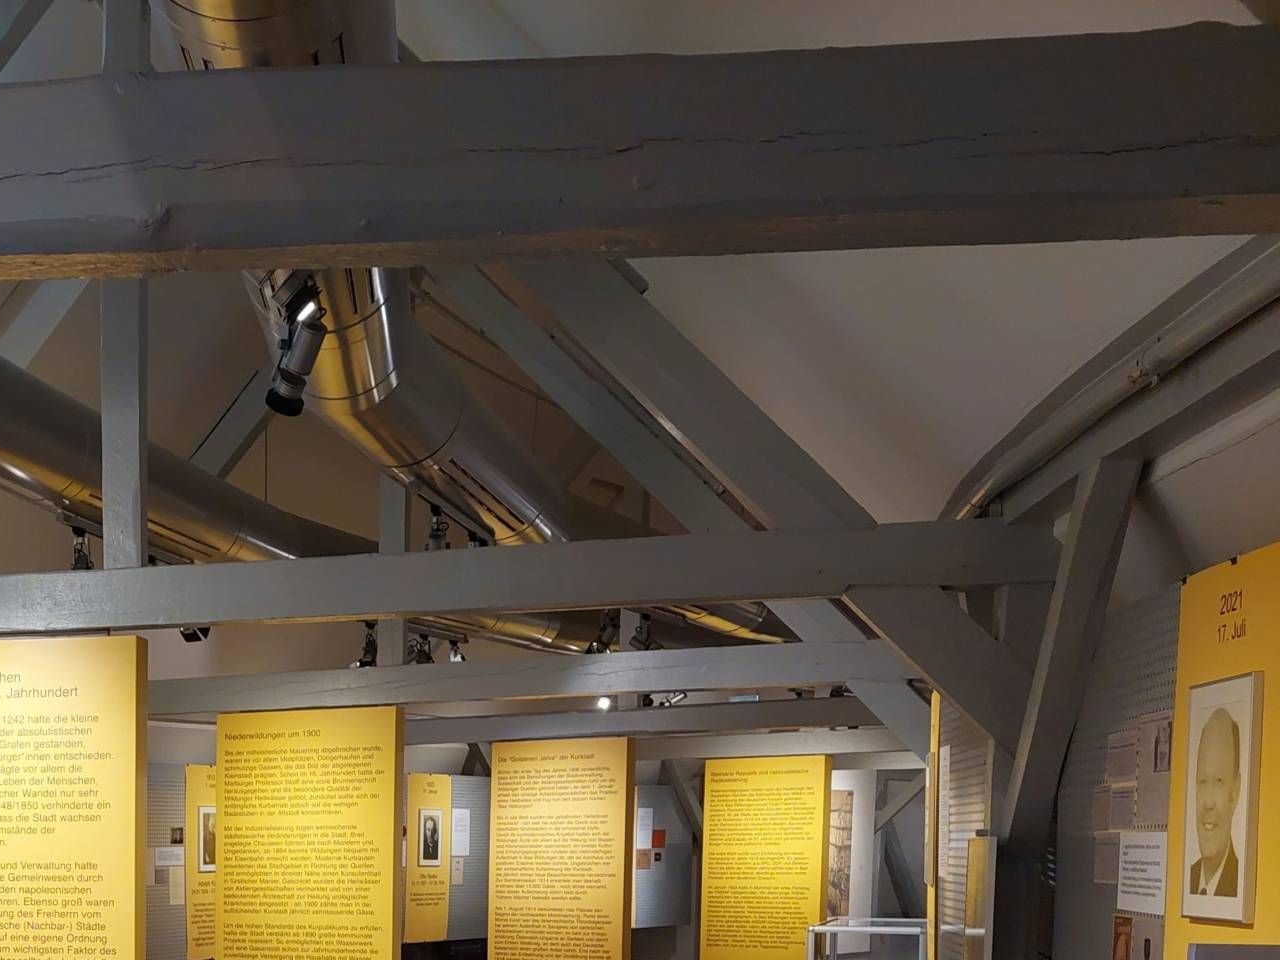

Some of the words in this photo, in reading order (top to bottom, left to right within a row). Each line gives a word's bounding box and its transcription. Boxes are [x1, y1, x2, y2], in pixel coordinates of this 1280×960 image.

[1220, 589, 1243, 615] 2021
[1217, 625, 1229, 643] 17.
[1231, 619, 1246, 639] Juli
[6, 686, 78, 698] Jahrhundert
[224, 731, 286, 740] Niederwildungen
[302, 728, 321, 737] 1900
